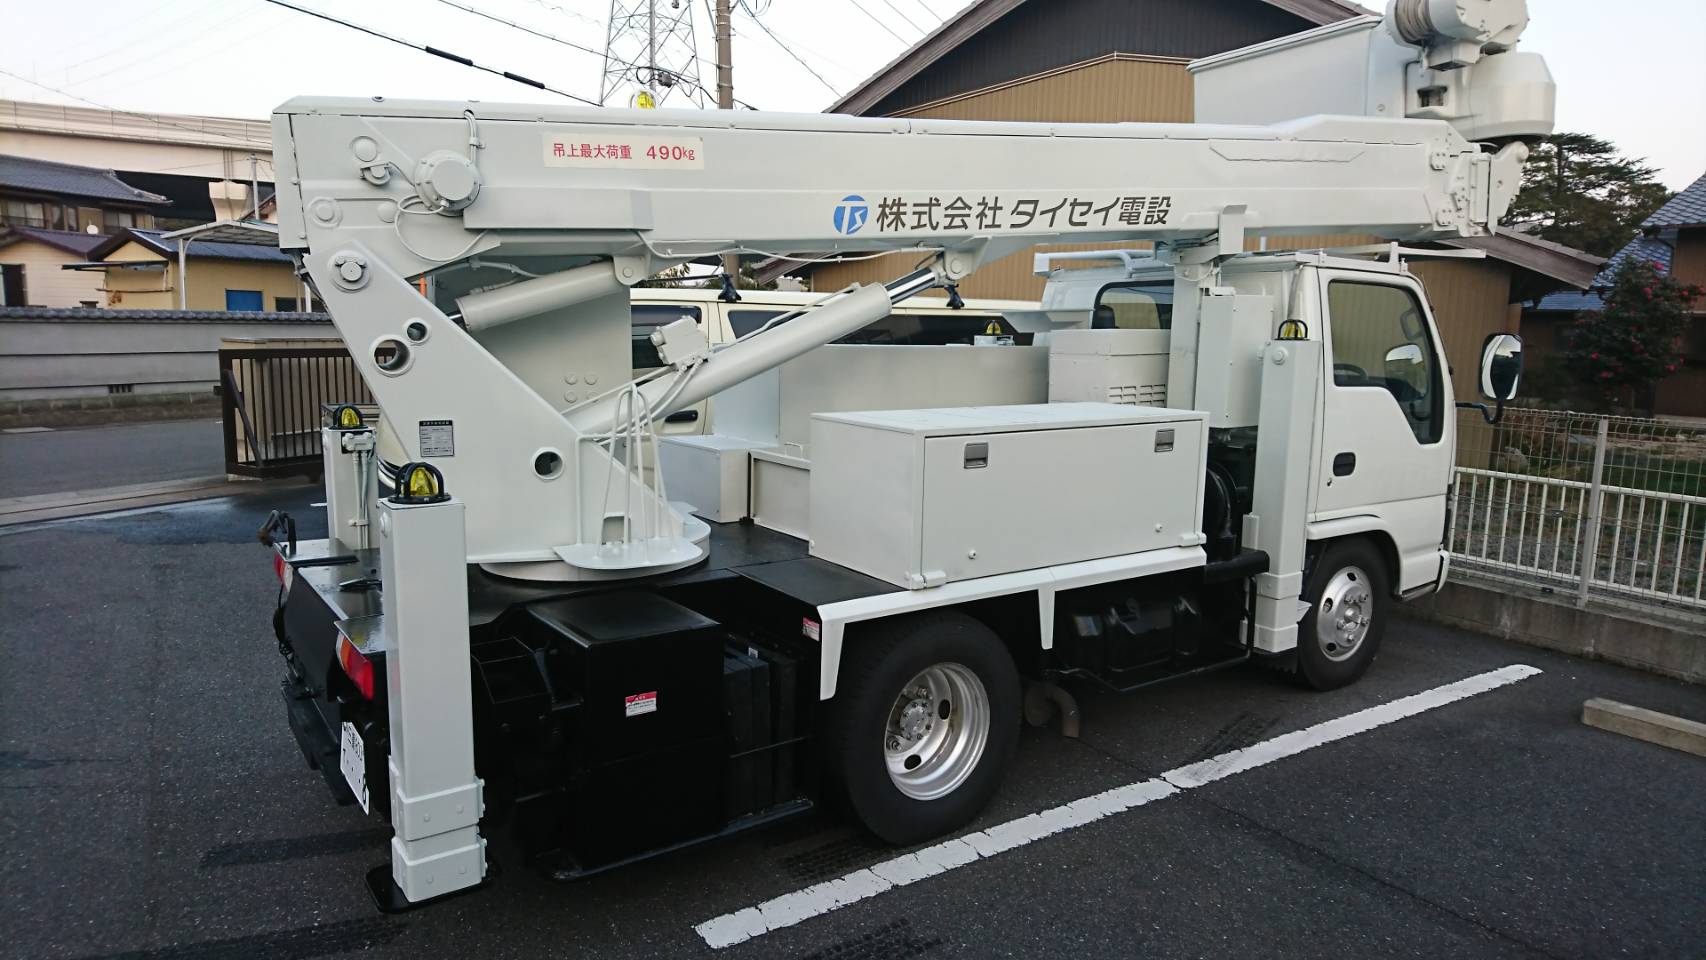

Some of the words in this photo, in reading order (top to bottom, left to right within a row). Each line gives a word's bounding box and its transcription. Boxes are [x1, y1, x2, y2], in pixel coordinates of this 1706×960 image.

[553, 143, 632, 160] 吊上最大荷重
[646, 145, 695, 161] 490kg
